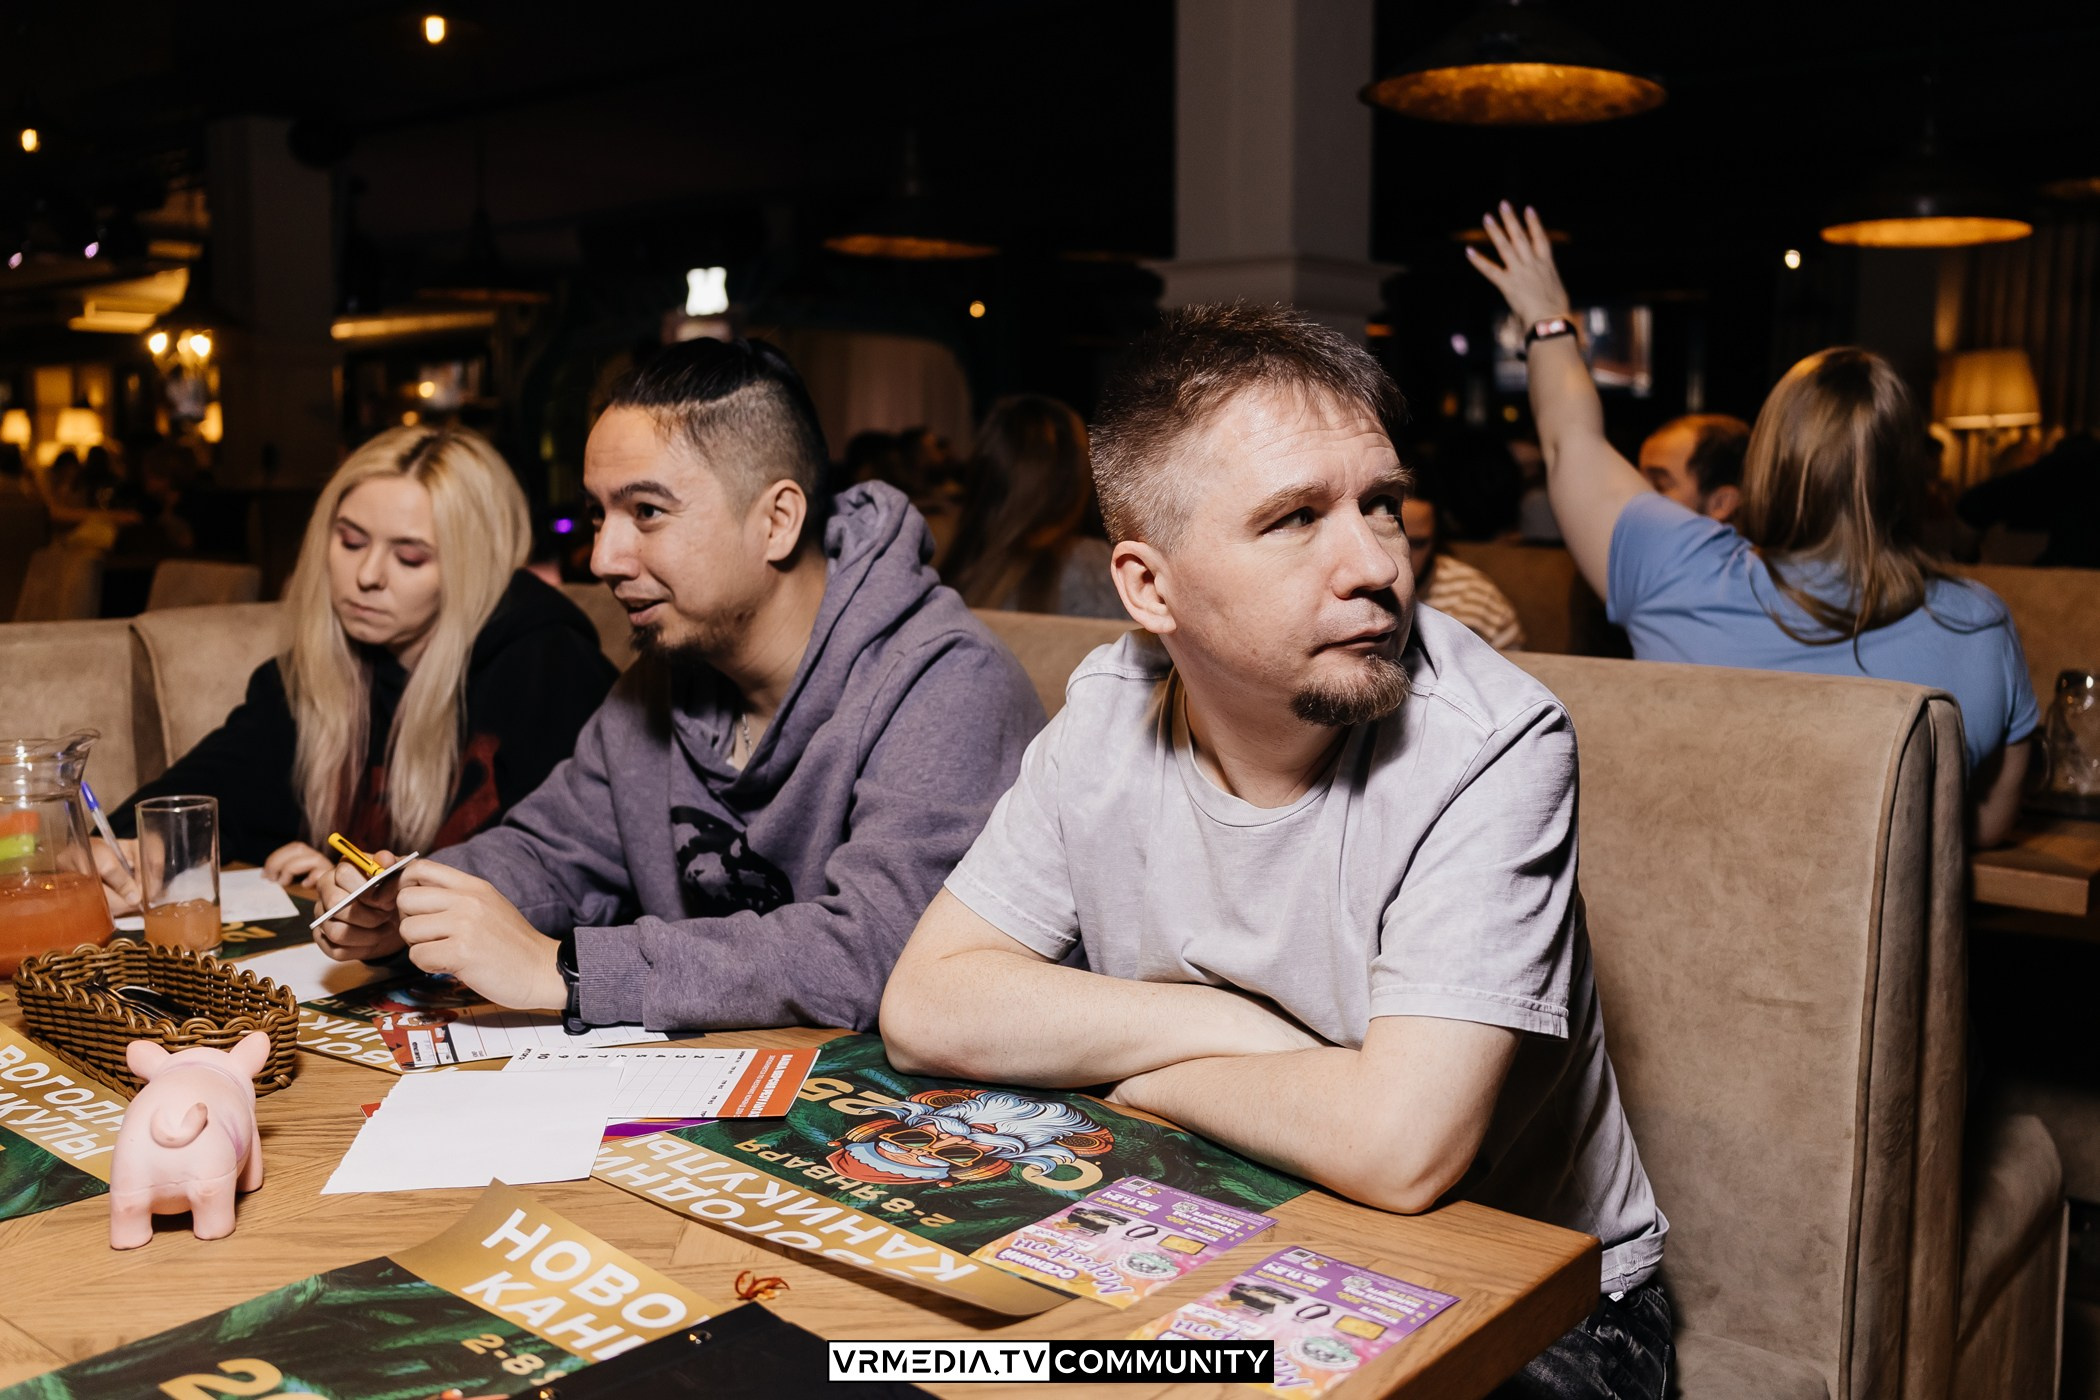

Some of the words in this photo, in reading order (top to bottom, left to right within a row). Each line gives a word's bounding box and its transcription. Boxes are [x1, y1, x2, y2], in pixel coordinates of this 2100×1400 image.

[734, 1139, 889, 1202] ЯНВАРЯ
[621, 1133, 979, 1283] КАНИКУЛЫ
[880, 1197, 956, 1228] 2-8
[999, 1248, 1077, 1280] ОСЕННИЙ
[1013, 1238, 1132, 1295] Марафон
[461, 1333, 546, 1376] 2-8
